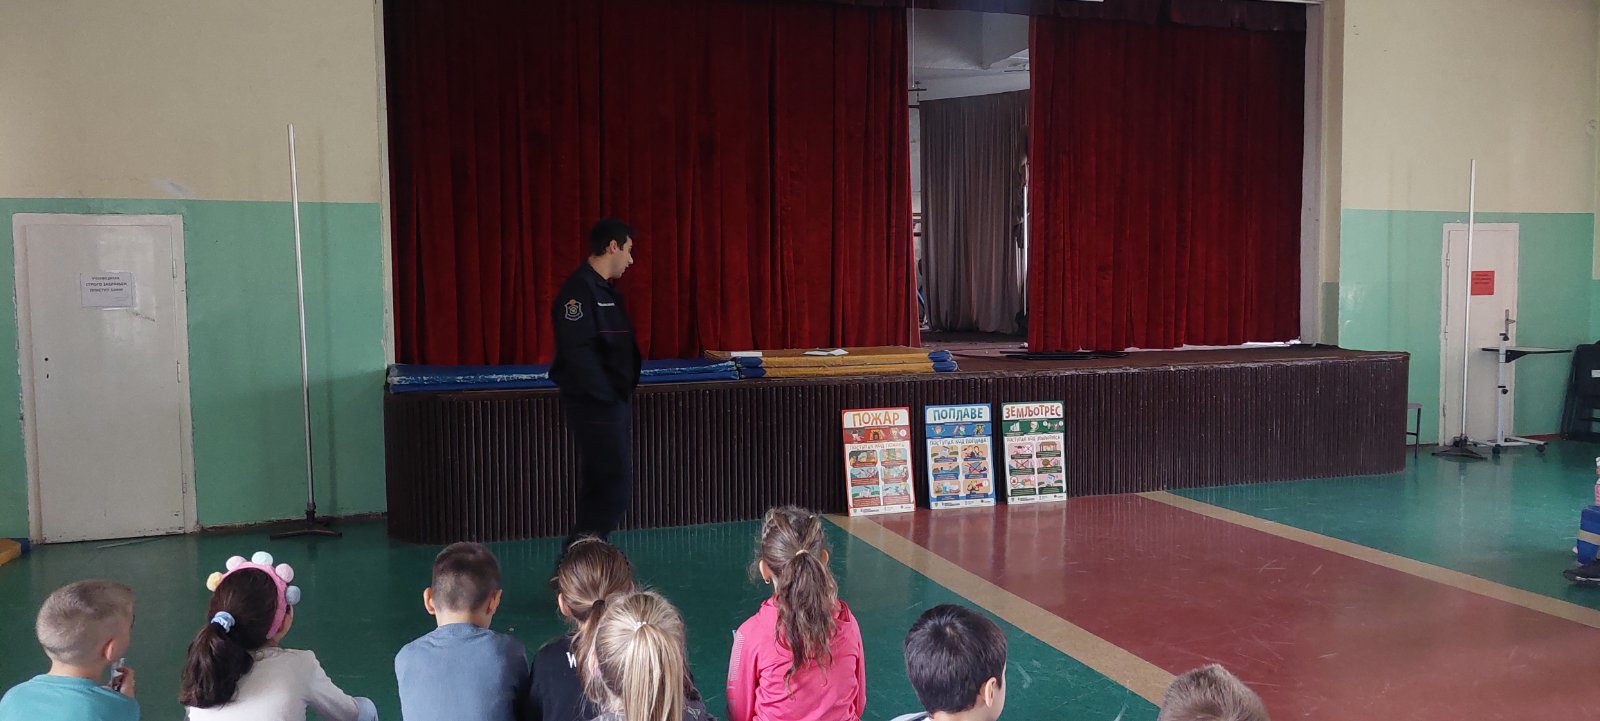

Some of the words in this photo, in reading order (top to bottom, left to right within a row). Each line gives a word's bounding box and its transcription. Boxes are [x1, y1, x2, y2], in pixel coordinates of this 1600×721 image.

[851, 411, 900, 427] ПОЖАР
[933, 407, 984, 421] ПОПЛАВЕ
[1005, 404, 1062, 419] ЗЕМЉОТРЕС
